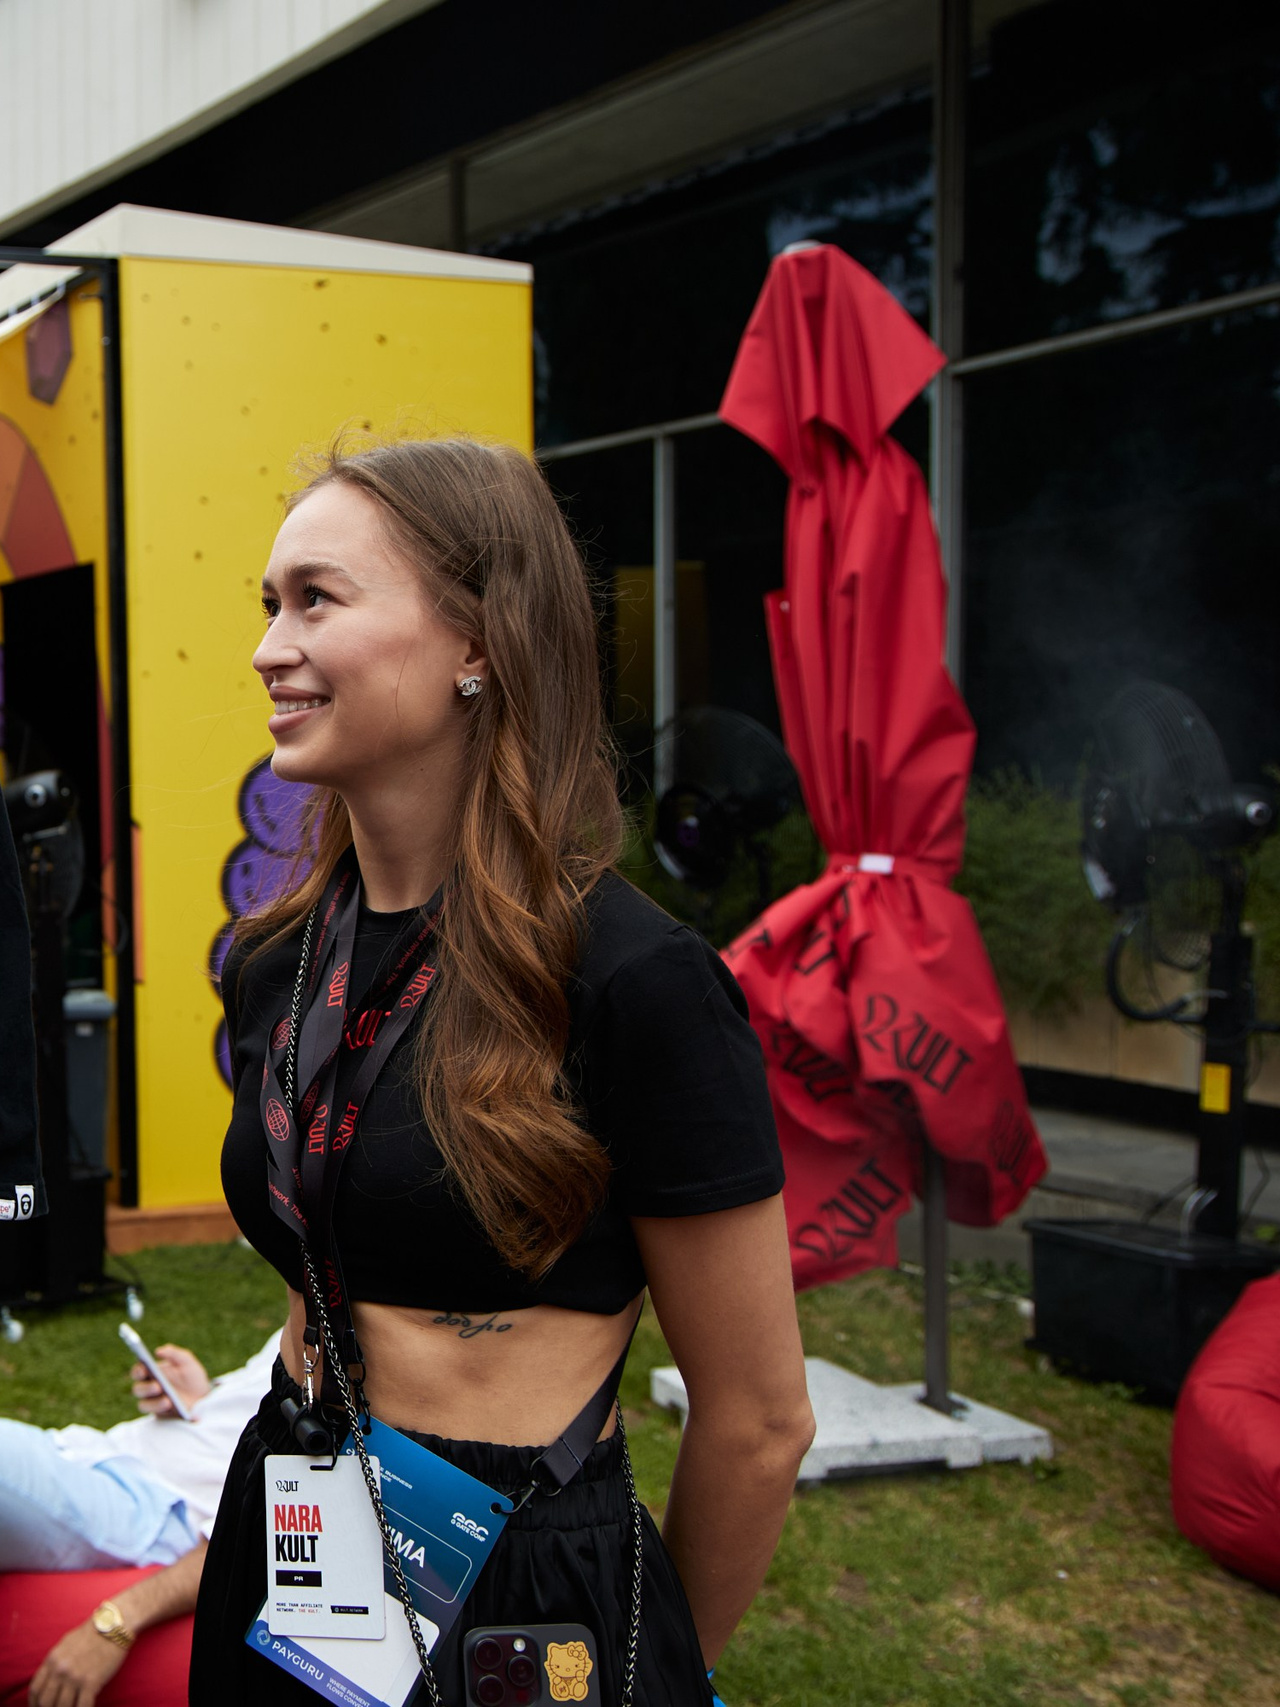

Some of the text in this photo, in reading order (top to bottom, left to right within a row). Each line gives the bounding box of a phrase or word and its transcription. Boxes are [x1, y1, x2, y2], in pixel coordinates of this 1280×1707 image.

[385, 1469, 413, 1489] BUSINESS
[274, 1504, 323, 1532] NARA
[456, 1522, 470, 1534] GATE
[470, 1530, 486, 1542] CONF
[275, 1534, 318, 1562] KULT
[271, 1641, 324, 1680] PAYGURU
[326, 1683, 343, 1699] FLOWS
[329, 1677, 371, 1707] WHERE PAYMENT
